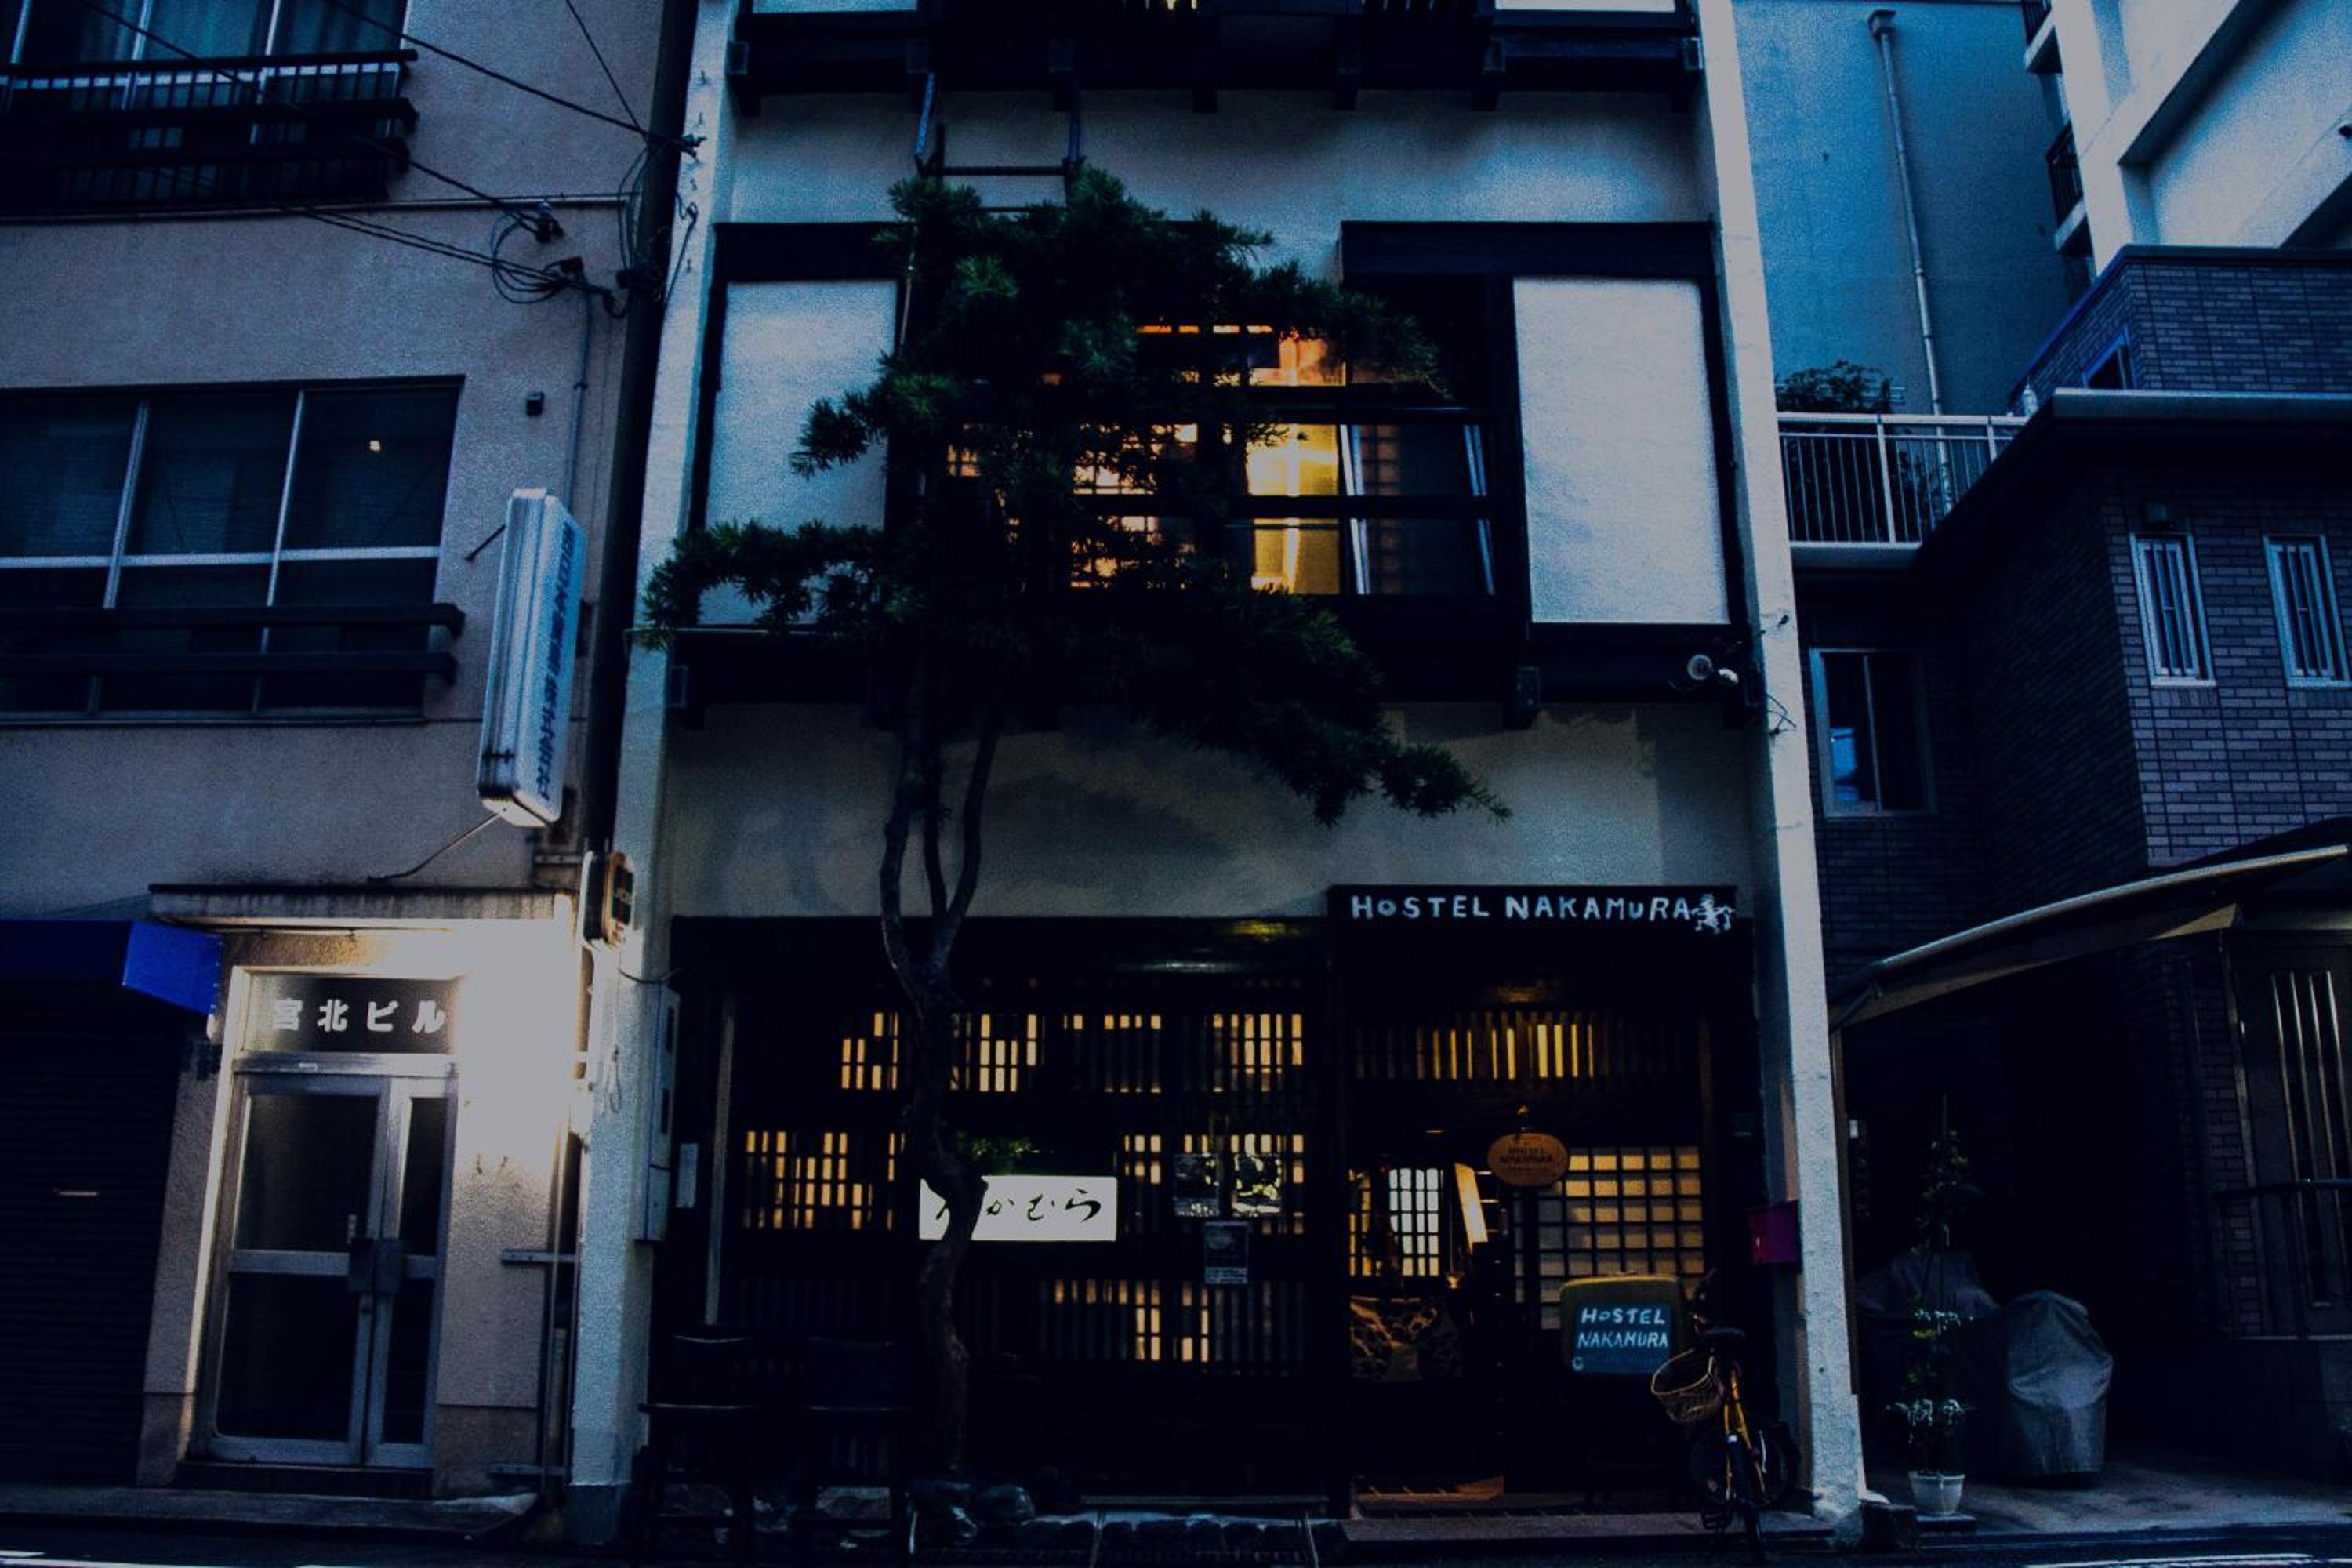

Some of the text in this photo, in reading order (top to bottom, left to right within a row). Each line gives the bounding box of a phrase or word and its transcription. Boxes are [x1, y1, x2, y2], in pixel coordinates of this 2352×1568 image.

[1349, 894, 1692, 921] HOSTEL NAKAMURA
[935, 1187, 1102, 1222] かむら
[1580, 1307, 1667, 1327] HOSTEL
[1575, 1330, 1670, 1350] NAKAMURA
